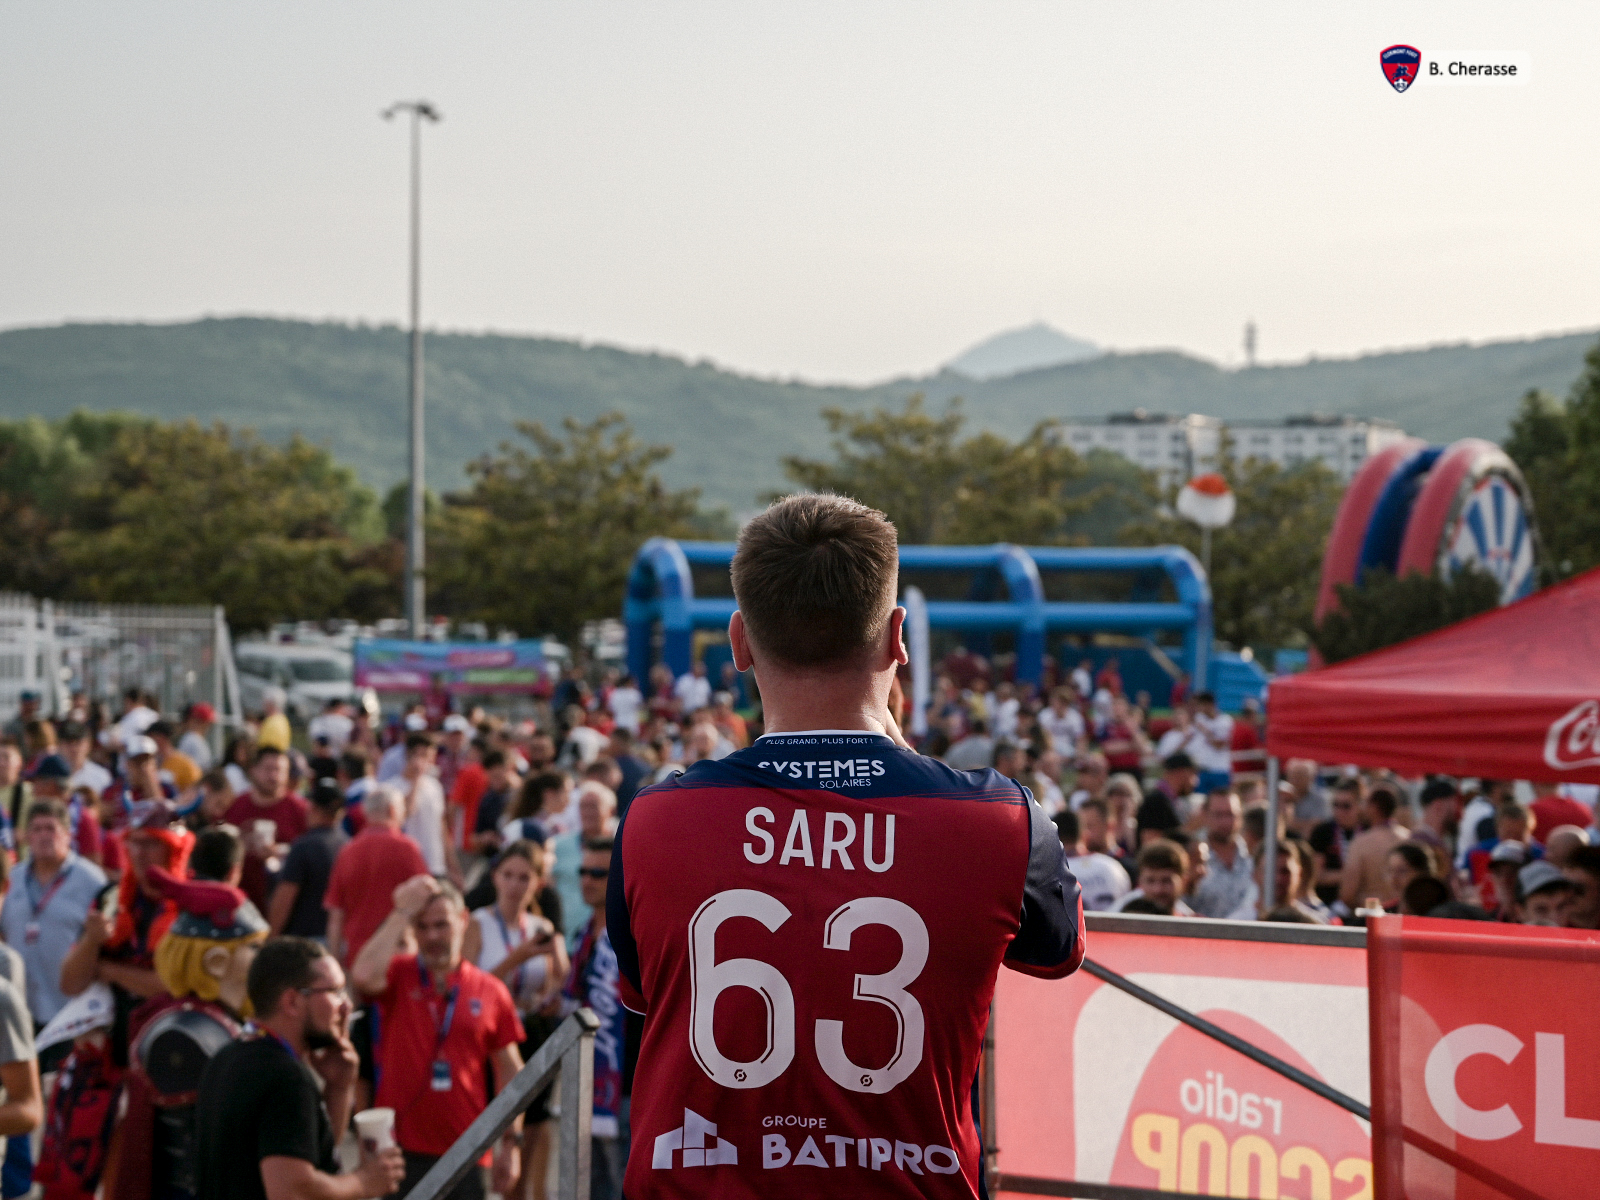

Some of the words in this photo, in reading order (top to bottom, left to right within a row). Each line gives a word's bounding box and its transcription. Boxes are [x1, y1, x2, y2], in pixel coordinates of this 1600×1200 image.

[821, 737, 844, 745] PLUS
[847, 737, 868, 745] FORT
[819, 778, 872, 789] SOLAIRES
[743, 806, 896, 873] SARU
[688, 888, 930, 1095] 63
[1424, 1023, 1600, 1150] CL
[762, 1115, 827, 1129] GROUPE
[762, 1133, 960, 1176] BATIPRO
